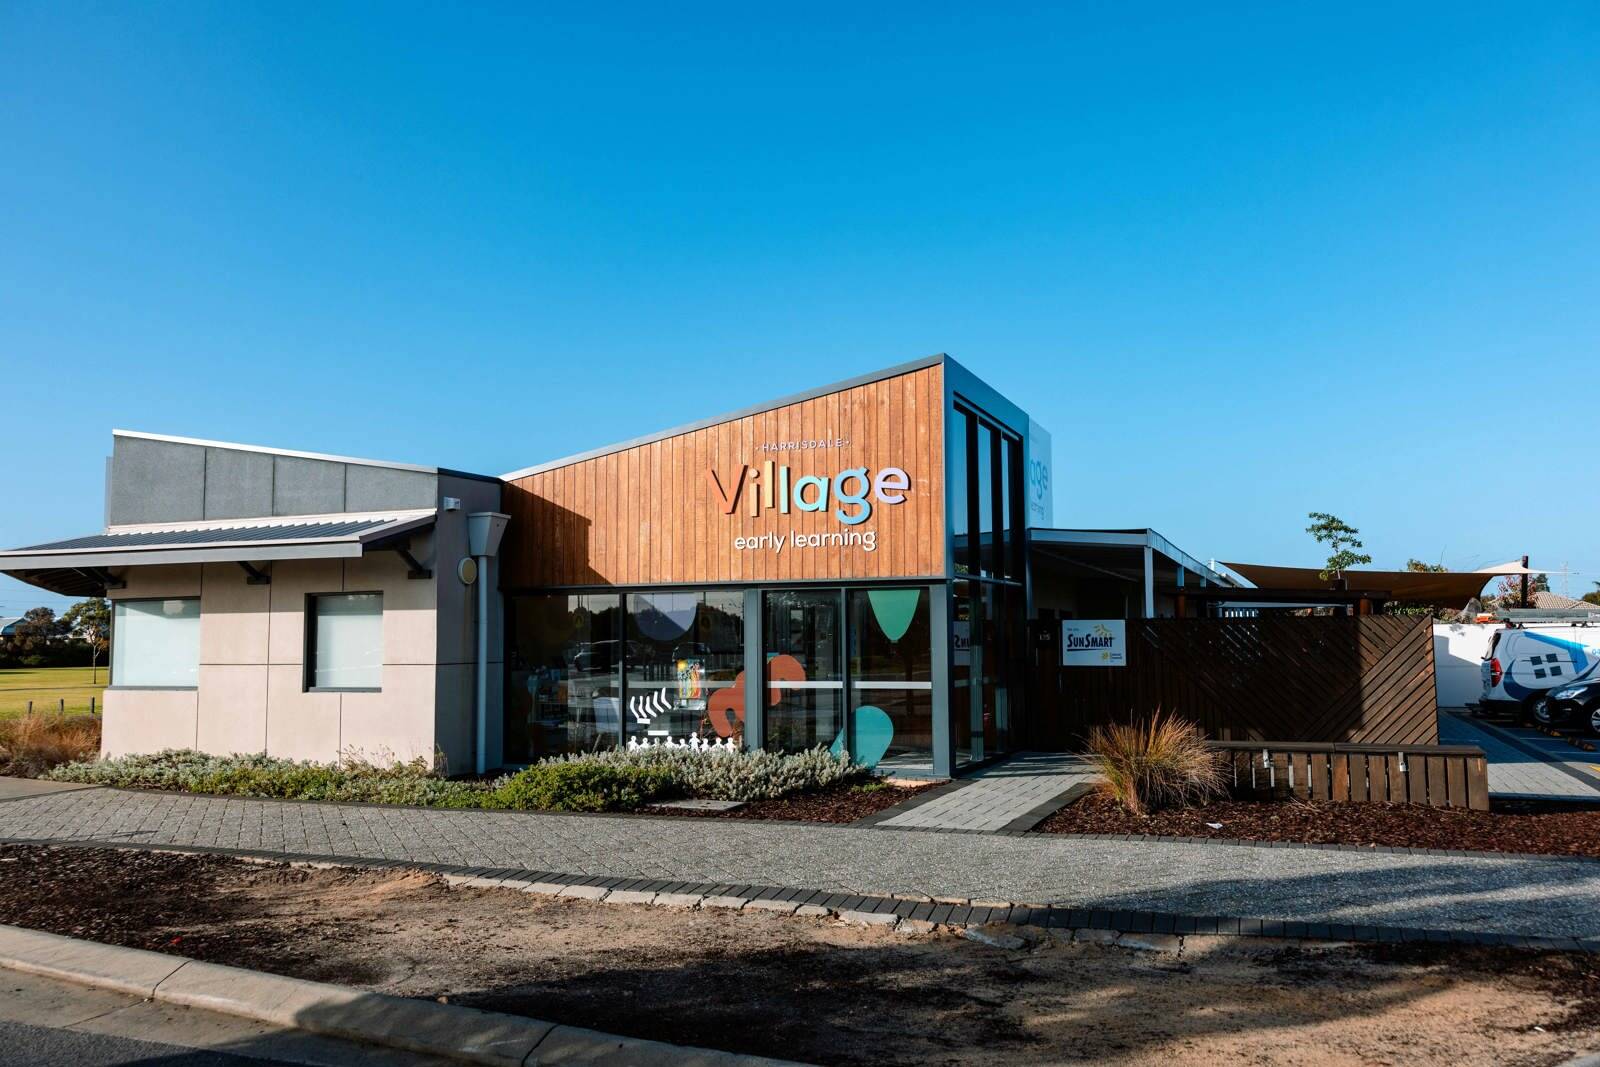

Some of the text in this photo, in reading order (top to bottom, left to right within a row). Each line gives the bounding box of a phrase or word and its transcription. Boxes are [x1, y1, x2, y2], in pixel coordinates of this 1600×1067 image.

[761, 439, 844, 451] HARRISDALE
[704, 460, 910, 525] Village
[735, 529, 877, 553] early learning
